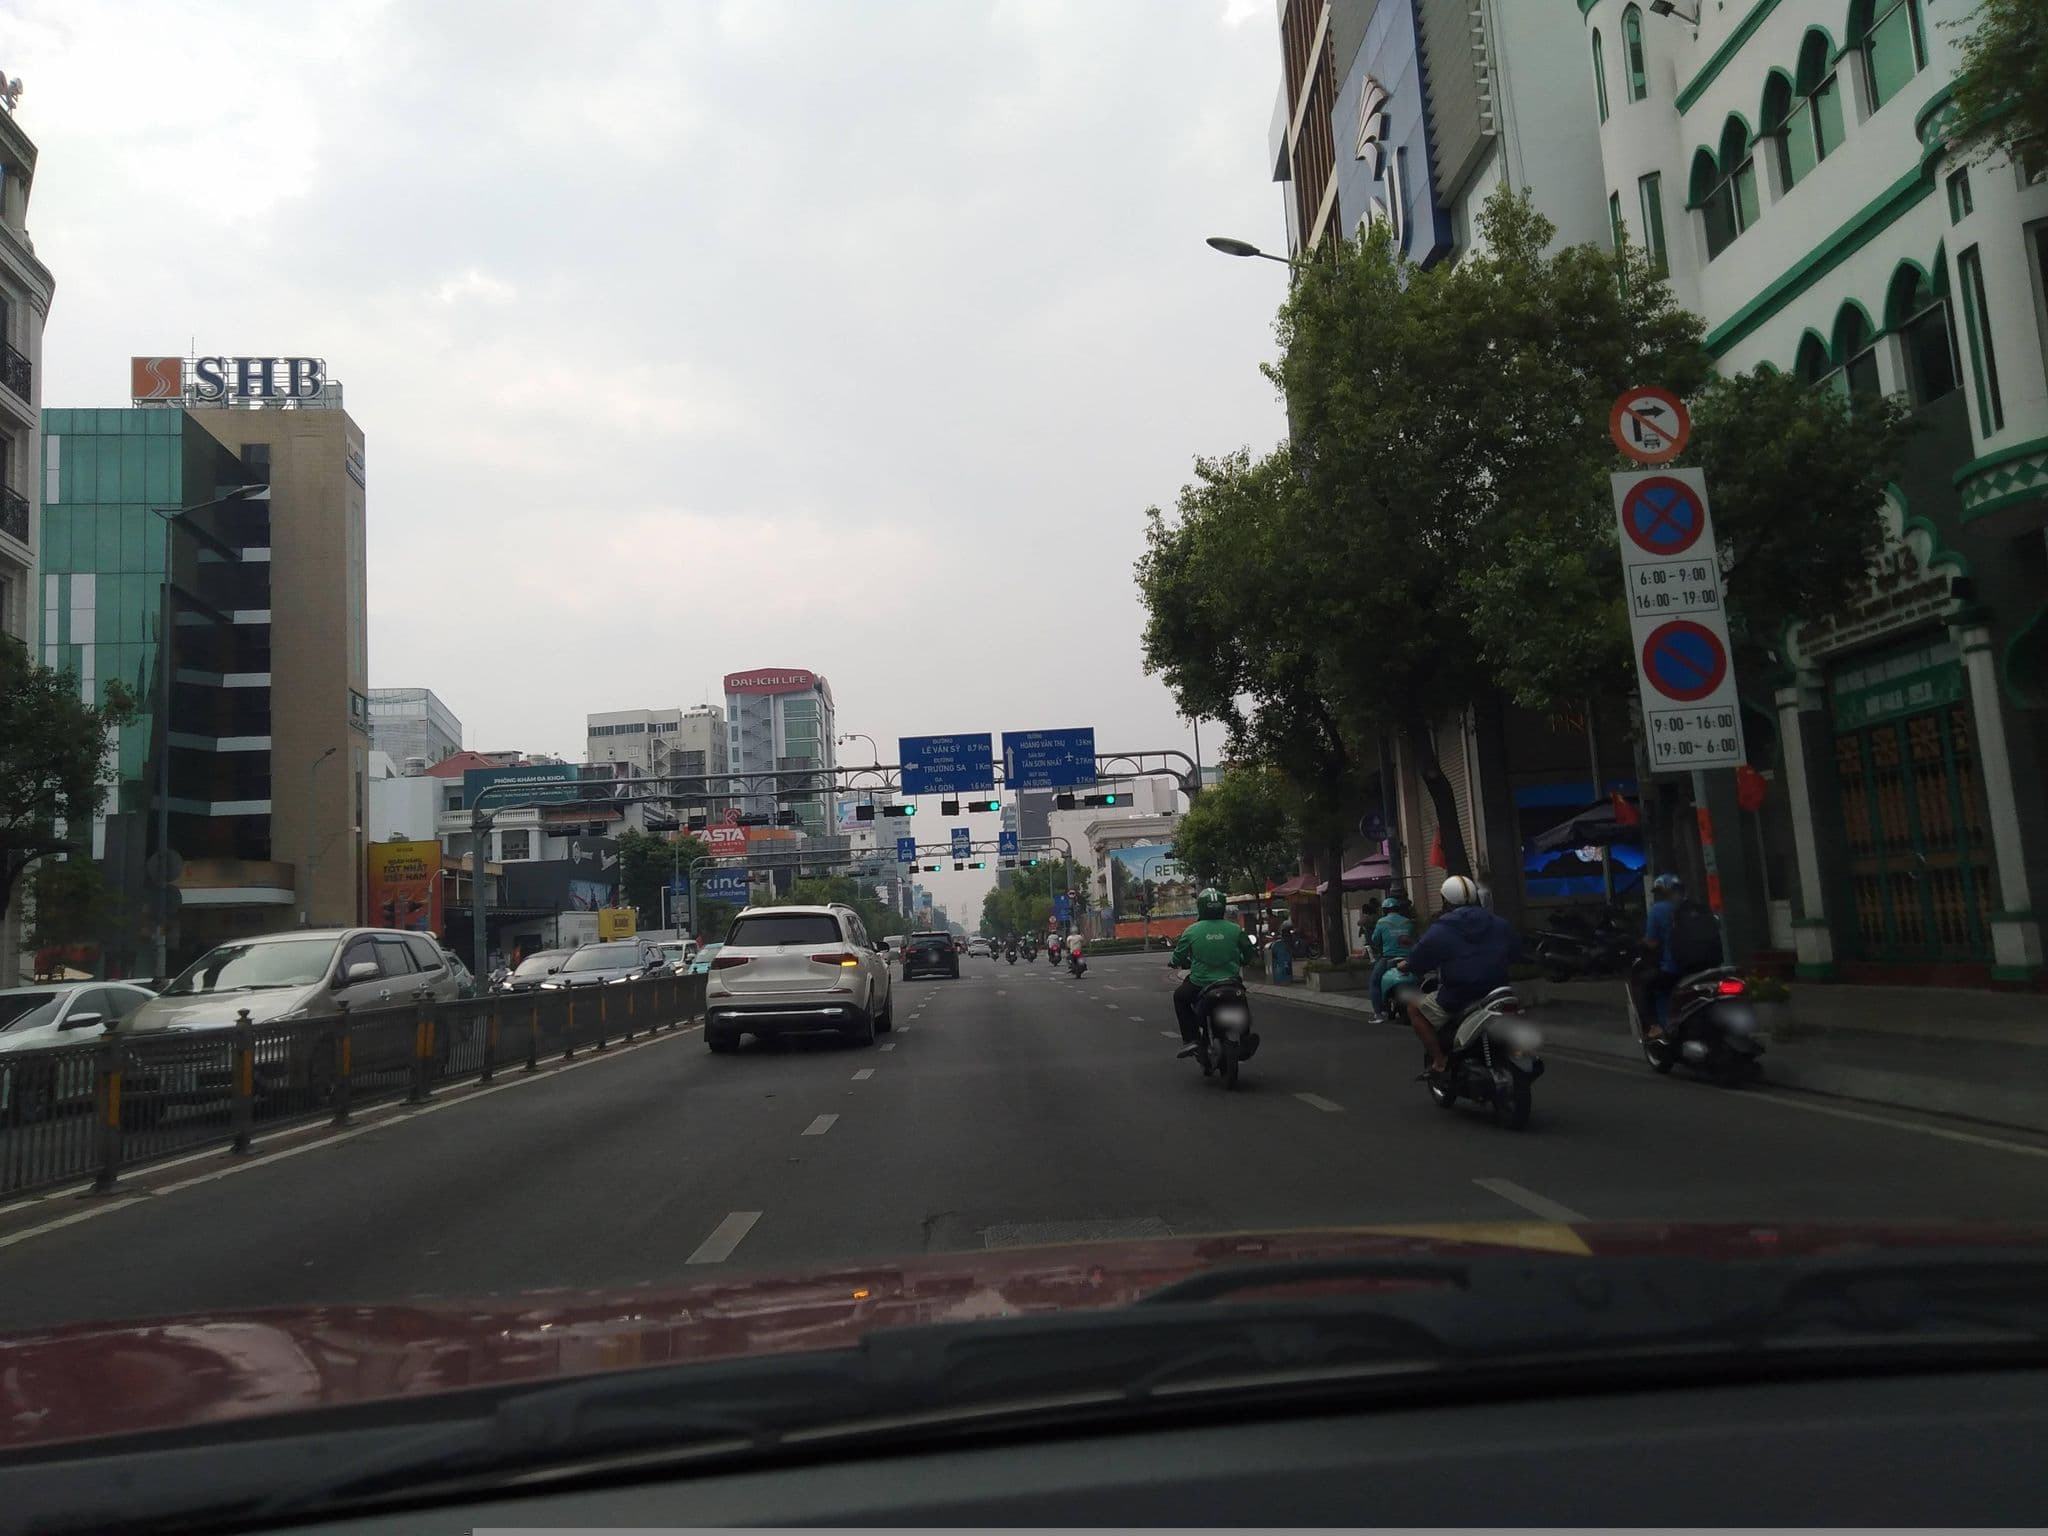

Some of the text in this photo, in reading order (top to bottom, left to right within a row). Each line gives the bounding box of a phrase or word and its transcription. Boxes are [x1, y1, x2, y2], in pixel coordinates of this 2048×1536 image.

[194, 357, 325, 400] SHB
[731, 675, 807, 687] DAI-ICHI LIFE
